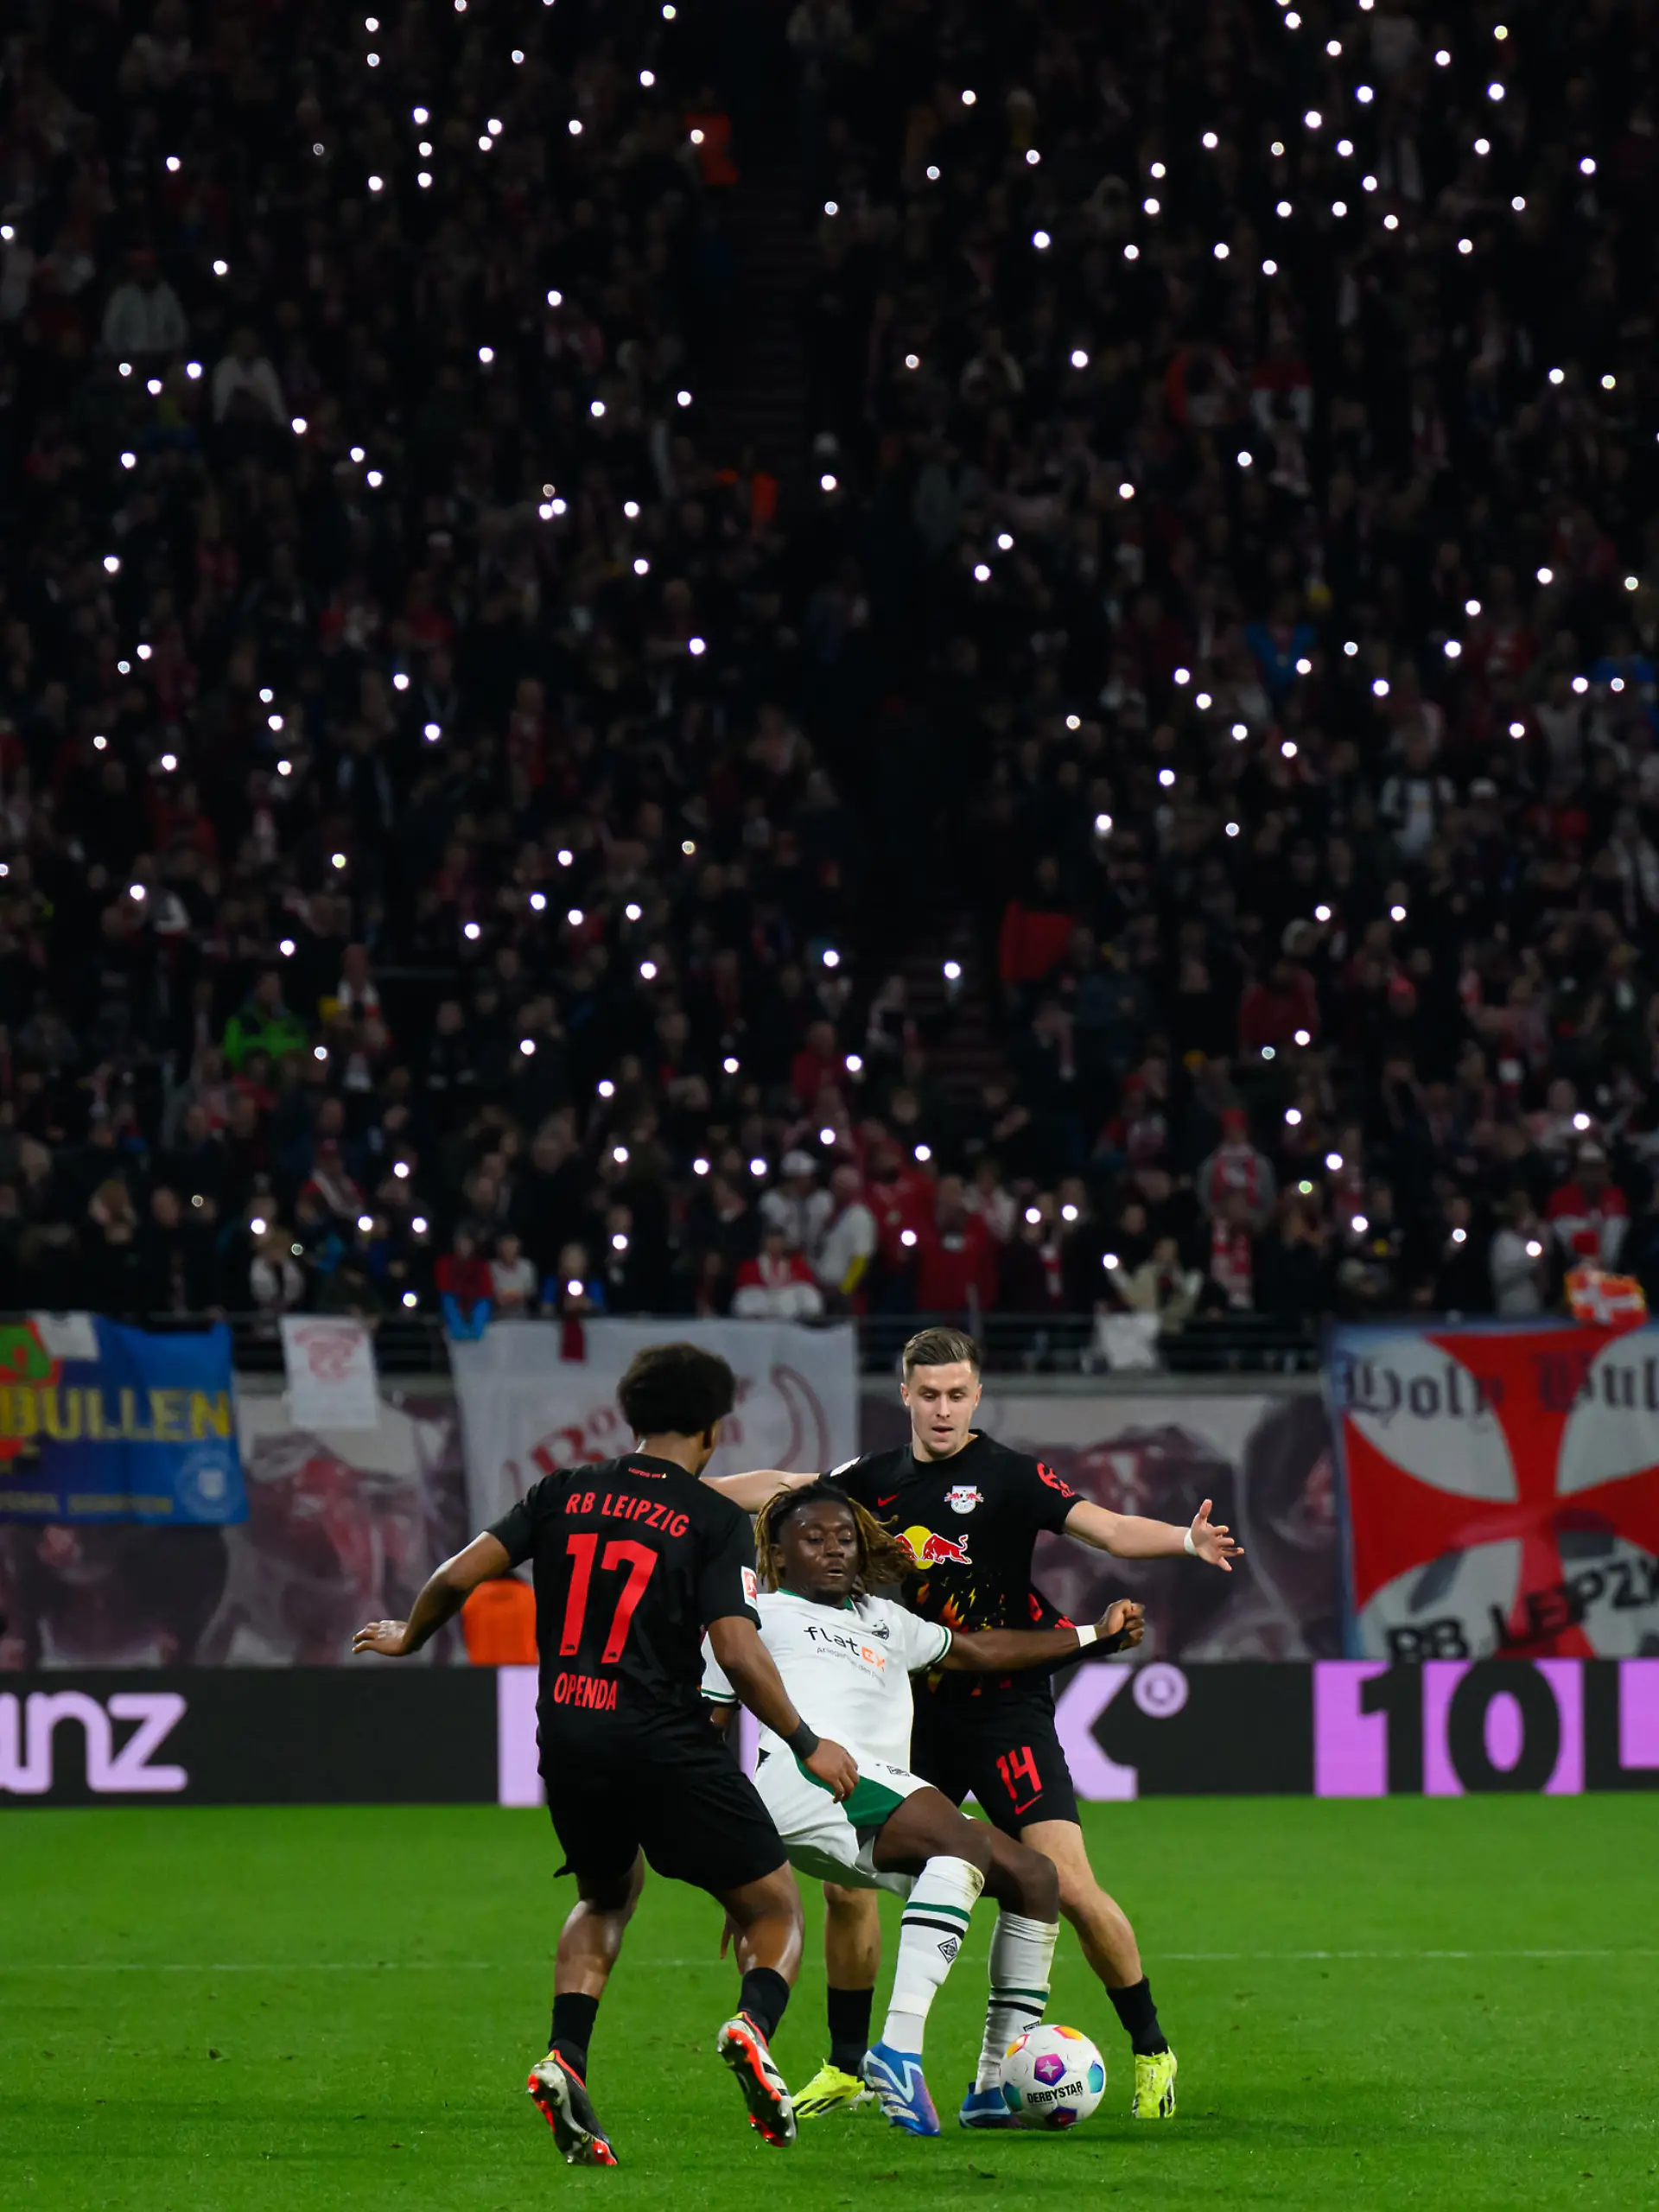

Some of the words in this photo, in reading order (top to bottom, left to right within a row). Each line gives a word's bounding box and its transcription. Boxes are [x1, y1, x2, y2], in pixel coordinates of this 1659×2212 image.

[0, 1386, 232, 1441] BULLEN
[565, 1491, 596, 1514] RB
[601, 1493, 690, 1537] LEIPZIG
[559, 1533, 658, 1664] 17
[553, 1672, 618, 1711] OPENDA
[995, 1746, 1043, 1800] 14
[1027, 2080, 1084, 2104] DERBYSTAR
